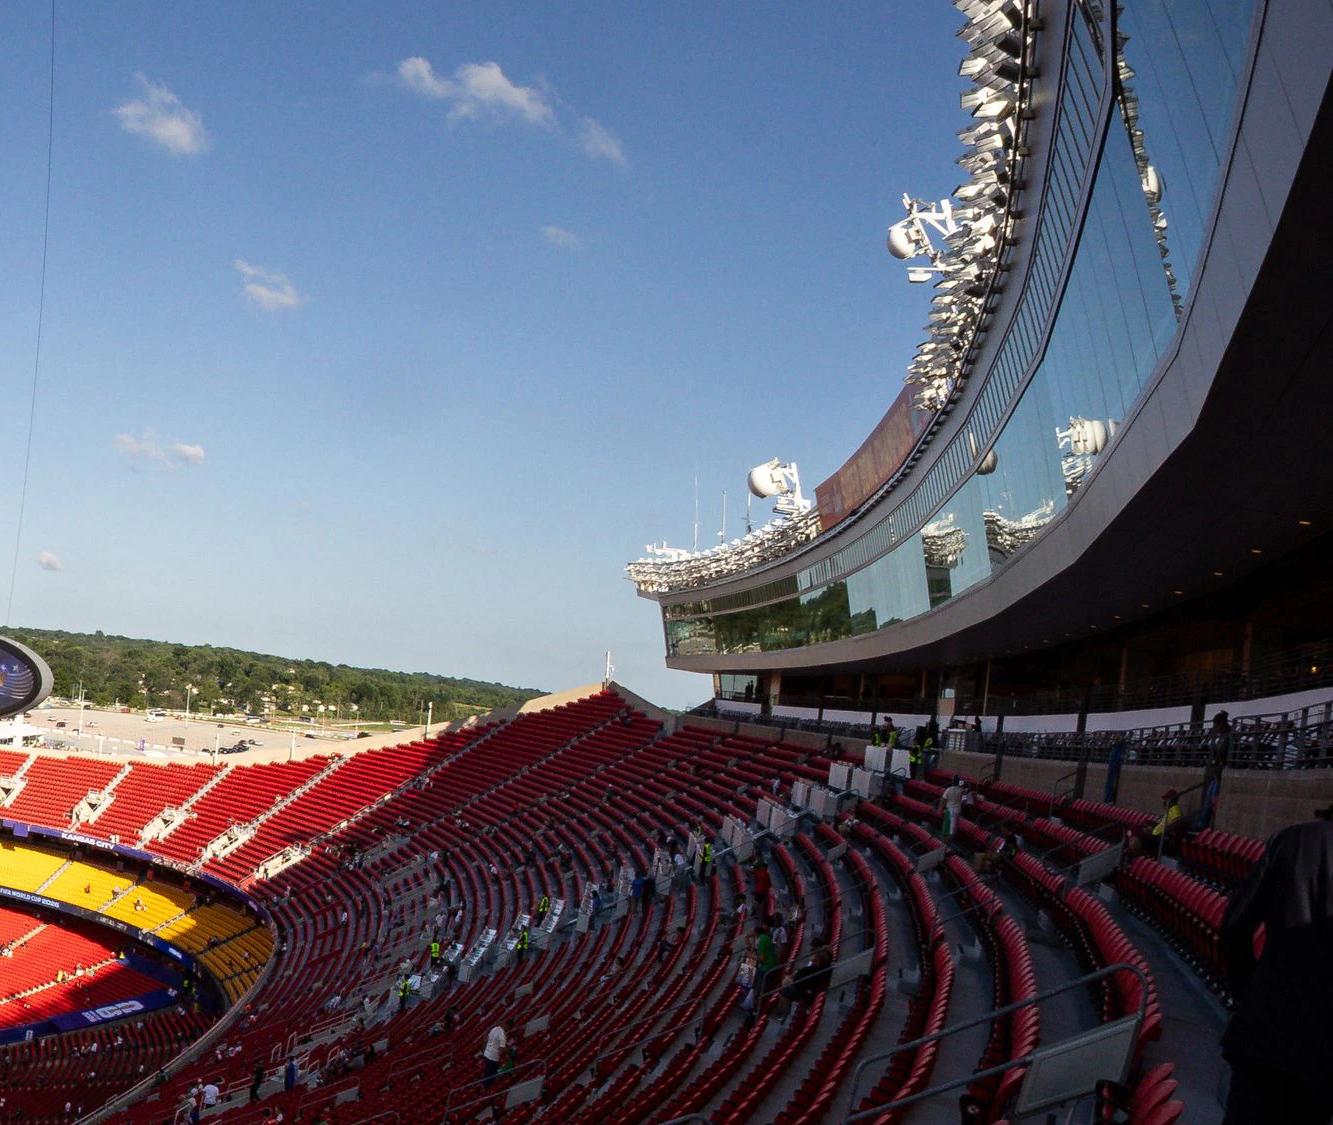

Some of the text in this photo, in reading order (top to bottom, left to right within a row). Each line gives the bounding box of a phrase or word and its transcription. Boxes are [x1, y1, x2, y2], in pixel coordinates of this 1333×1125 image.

[61, 831, 115, 850] KANSAS CITY
[0, 887, 60, 909] FIFA WORLD CUP 2026
